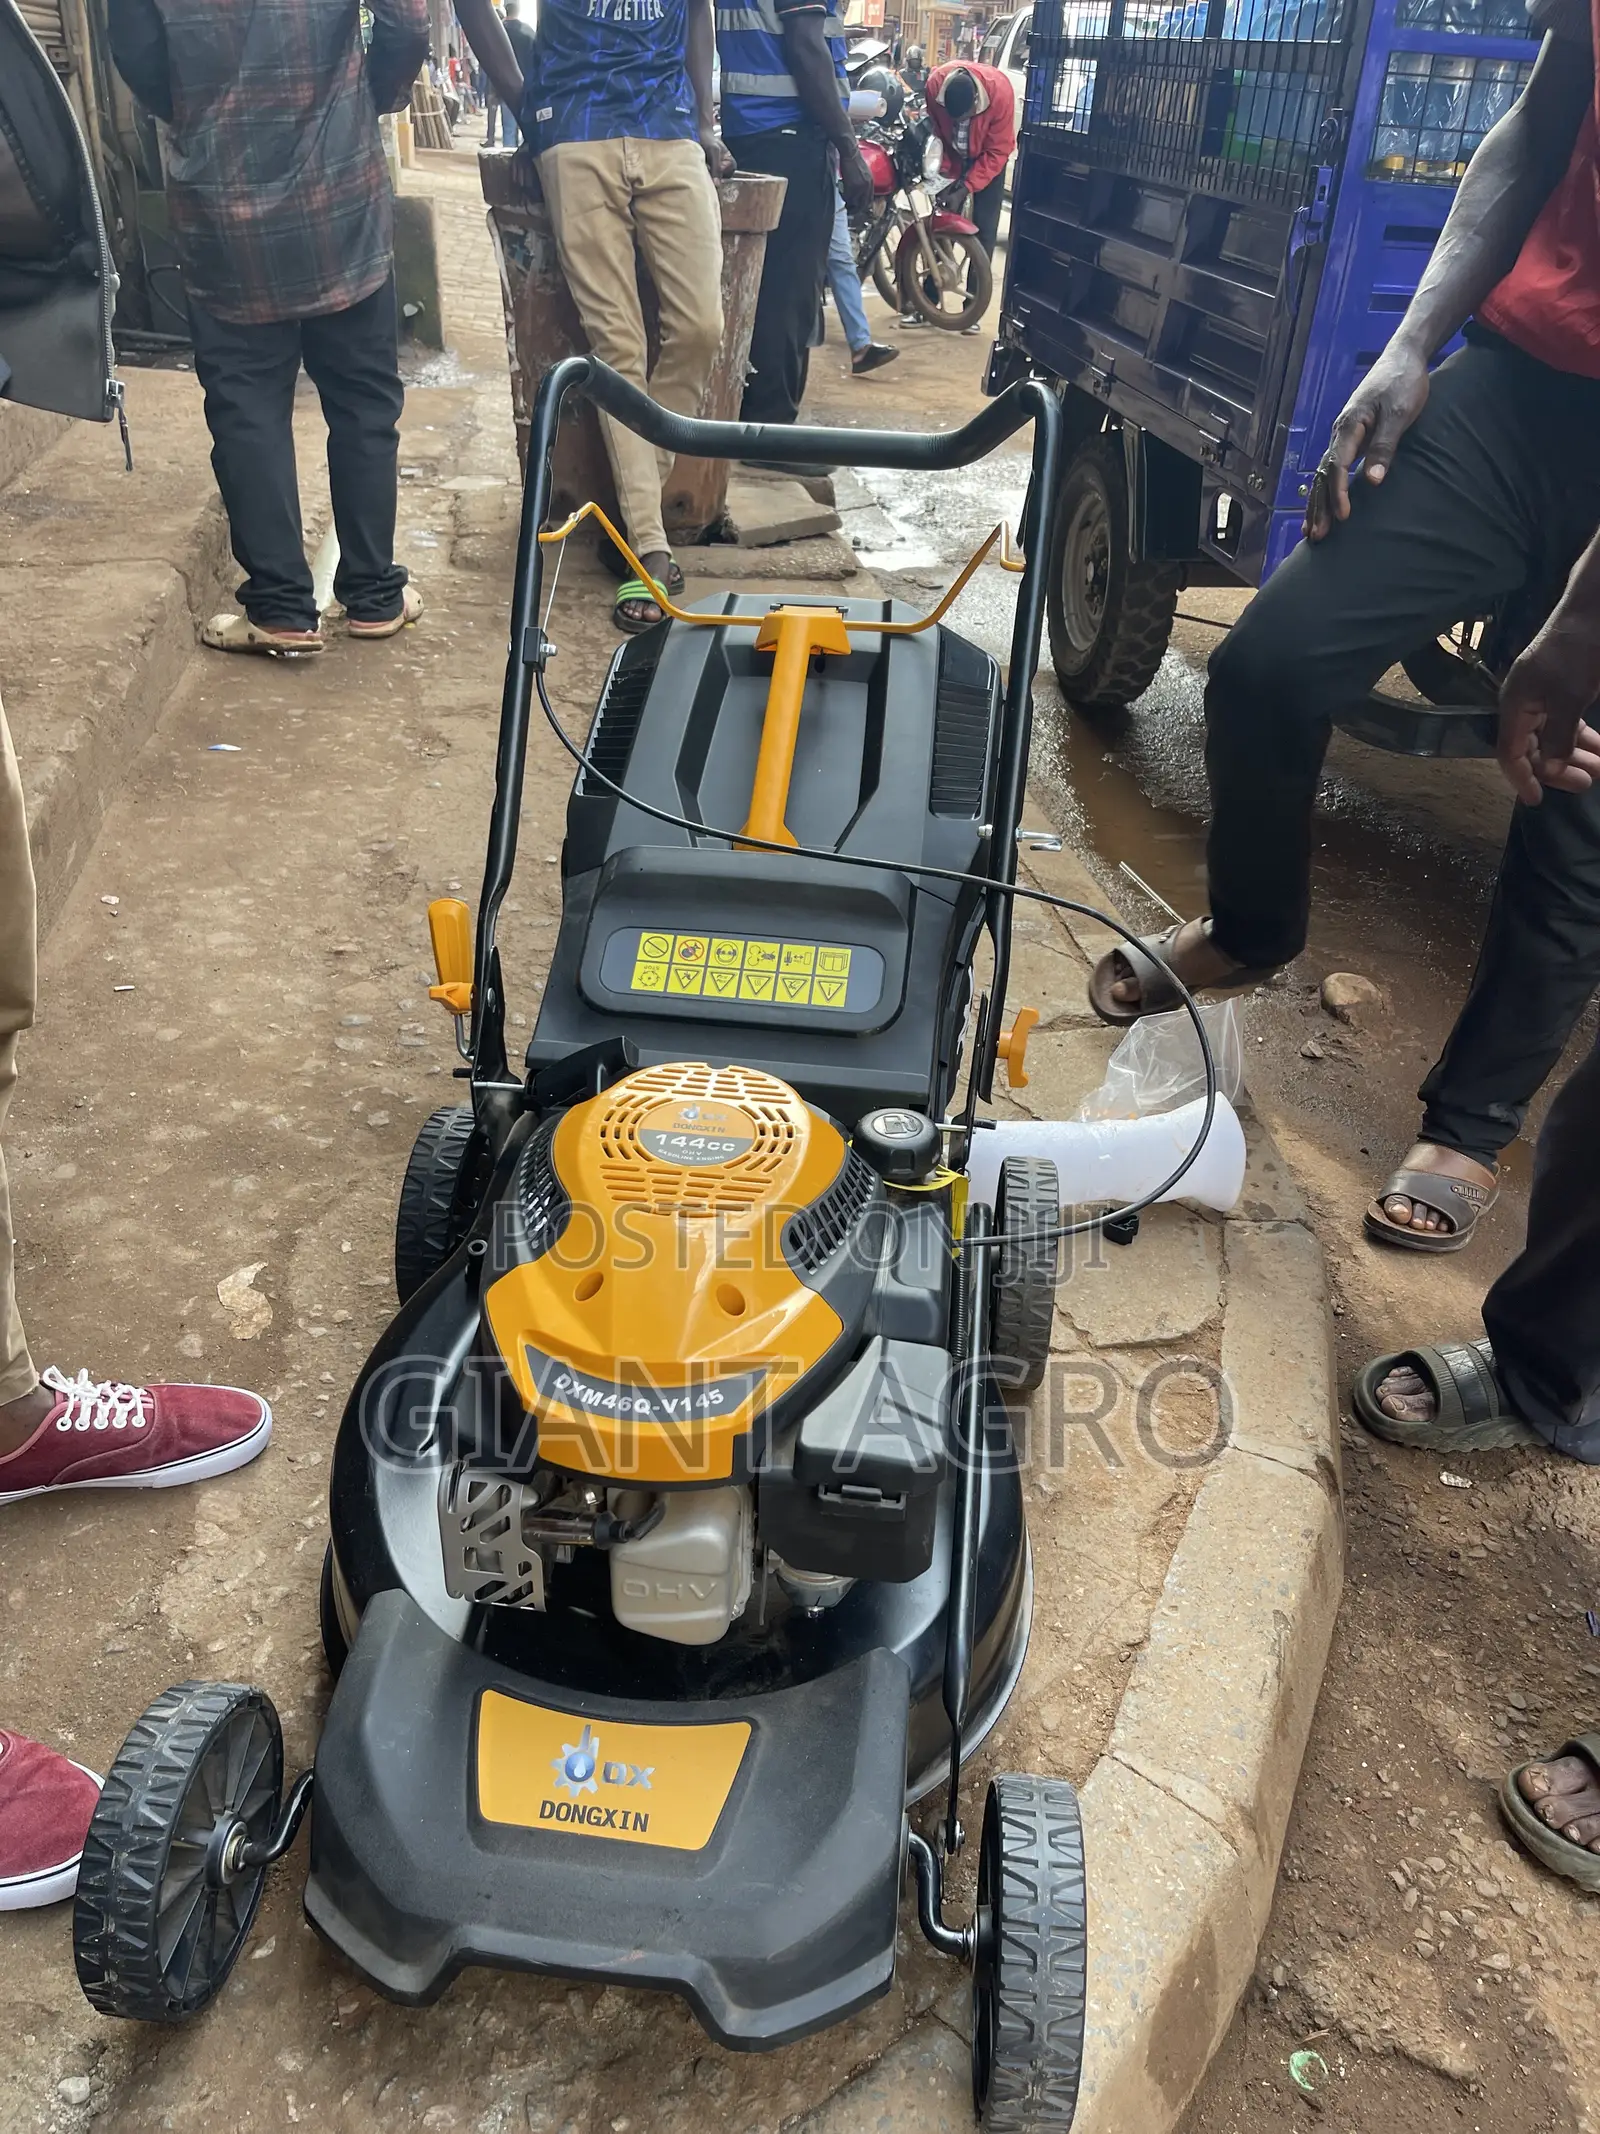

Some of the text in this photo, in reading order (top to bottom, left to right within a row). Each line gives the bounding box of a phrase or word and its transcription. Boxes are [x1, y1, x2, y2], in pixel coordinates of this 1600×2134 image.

[587, 0, 664, 21] FLY BETTER
[655, 1133, 736, 1152] 144cc
[552, 1372, 724, 1416] DXM46Q-V145
[623, 1578, 717, 1601] OHV
[538, 1799, 650, 1833] DONGXIN
